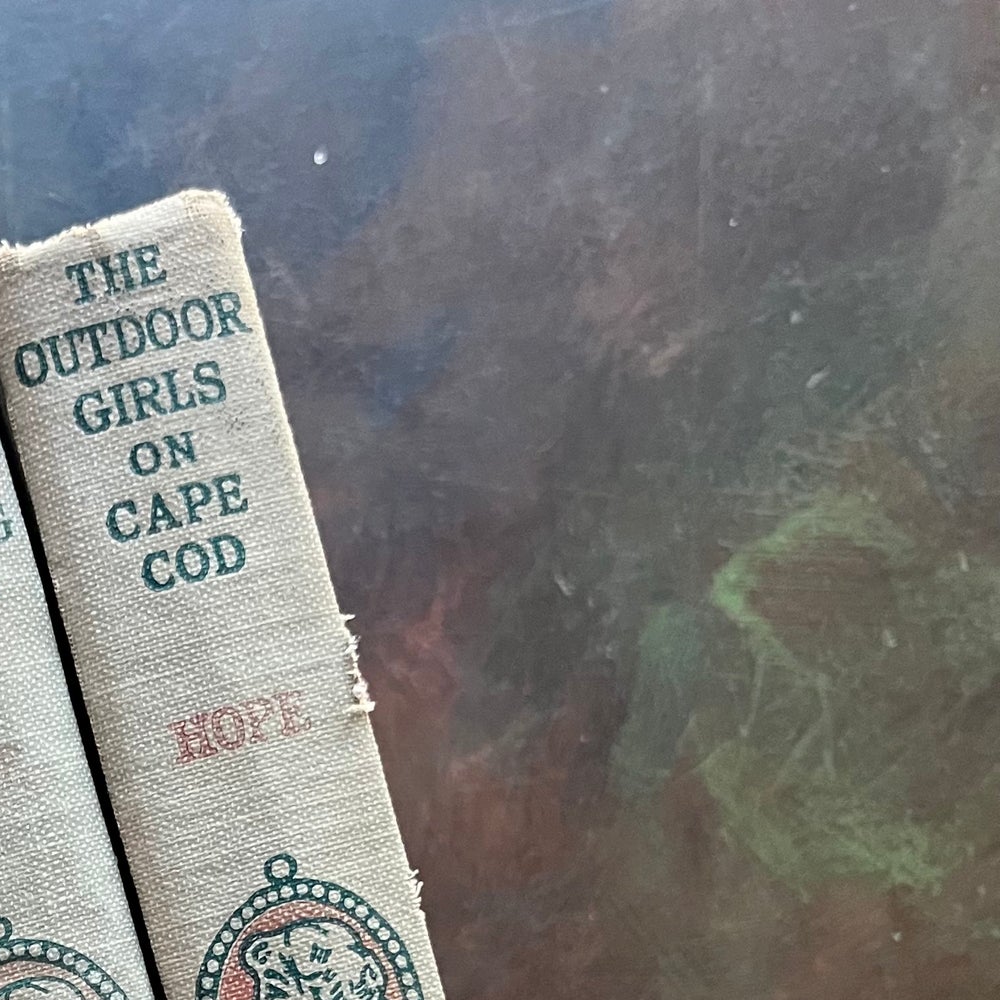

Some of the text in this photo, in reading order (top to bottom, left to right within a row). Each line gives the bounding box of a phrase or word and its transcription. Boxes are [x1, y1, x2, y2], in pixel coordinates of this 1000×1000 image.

[66, 244, 167, 304] THE
[14, 292, 252, 388] OUTDOOR
[73, 361, 227, 435] GIRLS
[129, 431, 196, 477] ON
[106, 474, 248, 545] CAPE
[141, 533, 246, 592] COD
[169, 690, 311, 765] HOPE
